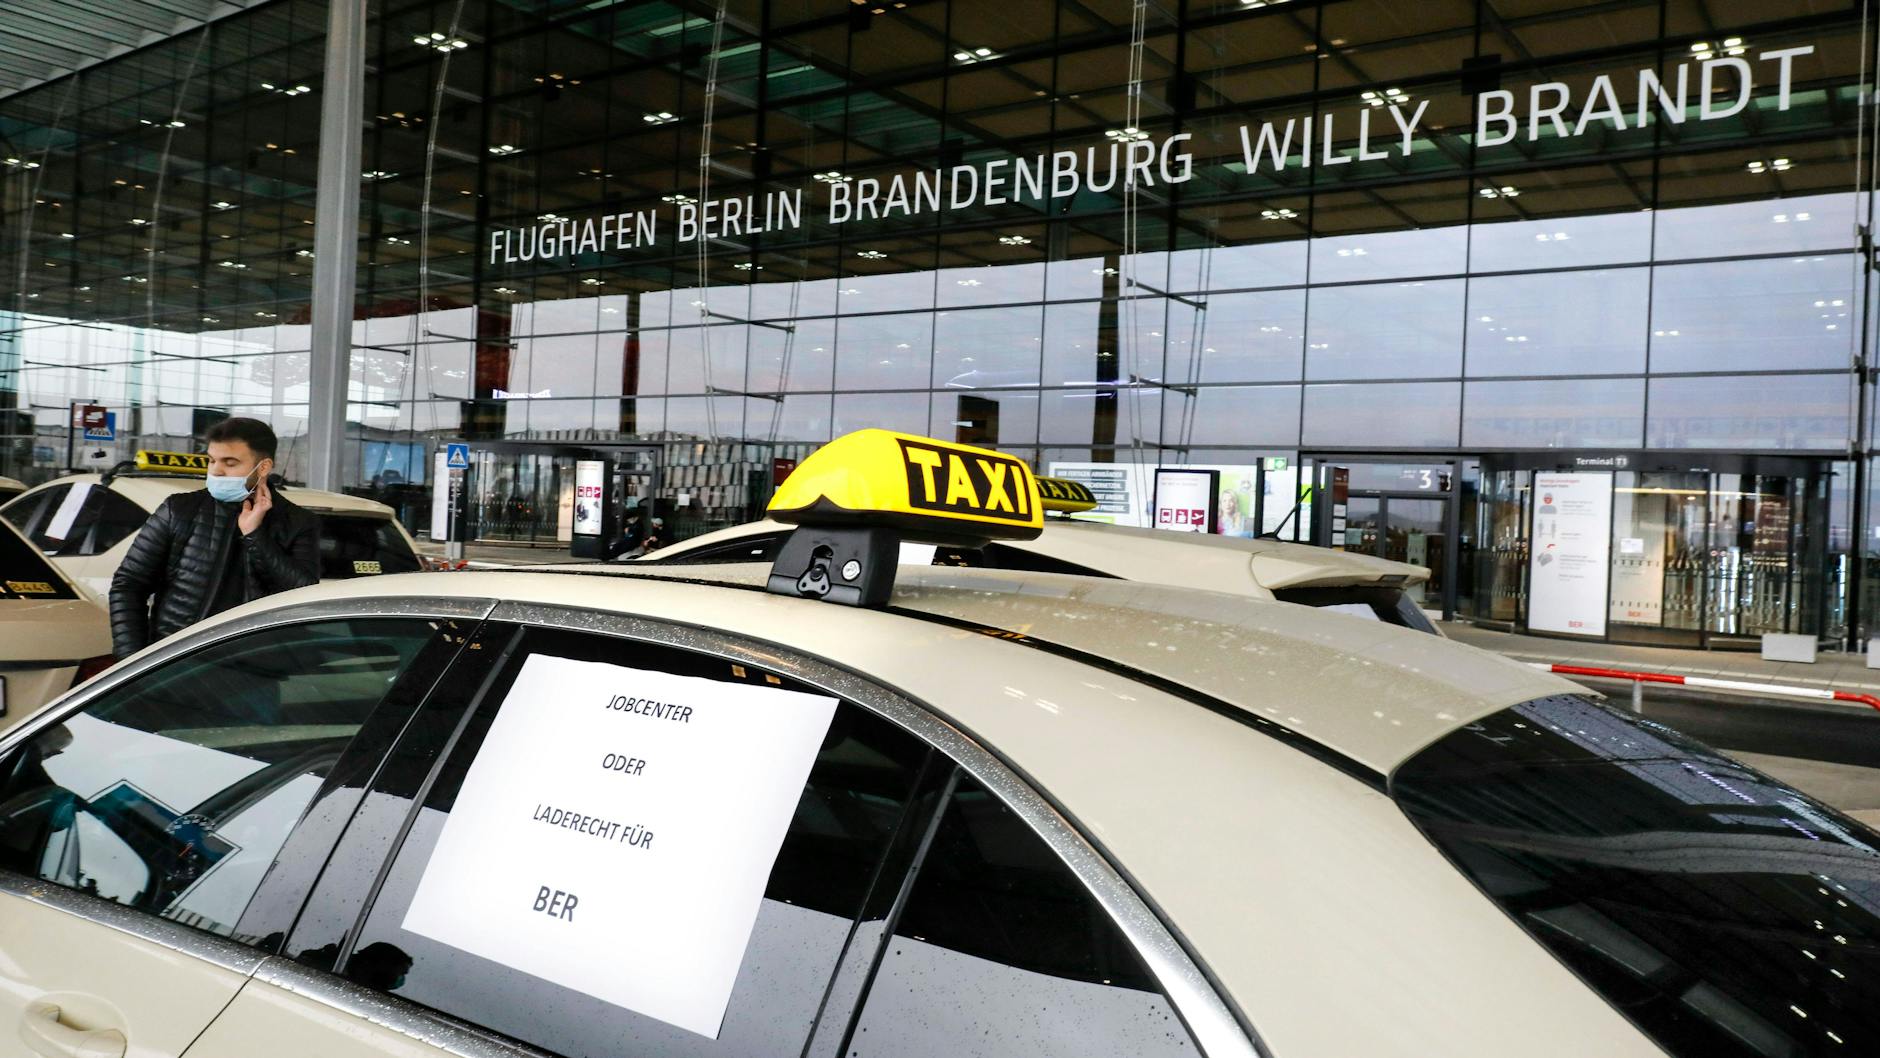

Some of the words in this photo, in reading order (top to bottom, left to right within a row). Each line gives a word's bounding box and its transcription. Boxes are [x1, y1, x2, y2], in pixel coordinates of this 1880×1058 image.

[490, 208, 656, 265] FLUGHAFEN
[677, 188, 802, 243] BERLIN
[828, 133, 1194, 225] BRANDENBURG
[1239, 99, 1430, 175] WILLY
[1475, 45, 1815, 148] BRANDT
[154, 454, 207, 468] TAXI
[1575, 457, 1614, 466] Terminal
[904, 446, 1029, 515] TAXI
[1418, 469, 1432, 489] 3
[606, 694, 693, 723] JOBCENTER
[602, 753, 646, 776] ODER
[533, 804, 621, 840] LADERECHT
[620, 824, 654, 850] FÜR
[533, 885, 579, 922] BER
